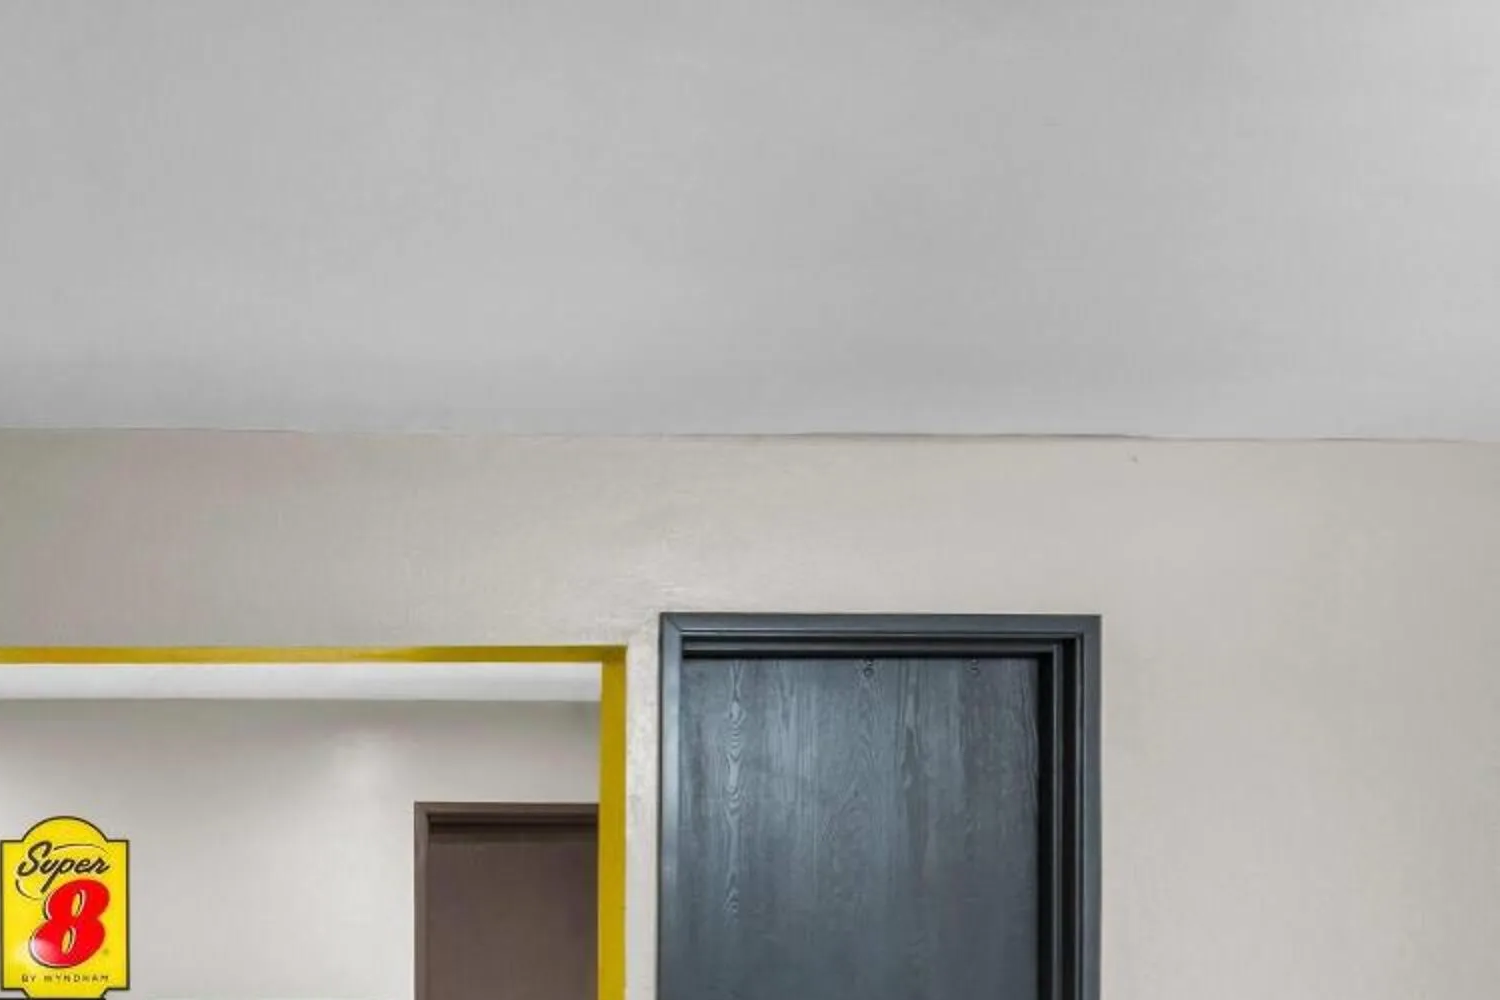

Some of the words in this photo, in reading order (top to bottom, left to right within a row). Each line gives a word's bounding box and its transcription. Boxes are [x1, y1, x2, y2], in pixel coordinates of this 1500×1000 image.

[16, 840, 111, 893] Super
[29, 878, 111, 969] 8
[21, 975, 36, 983] BY
[44, 974, 109, 983] WYNDHAM
